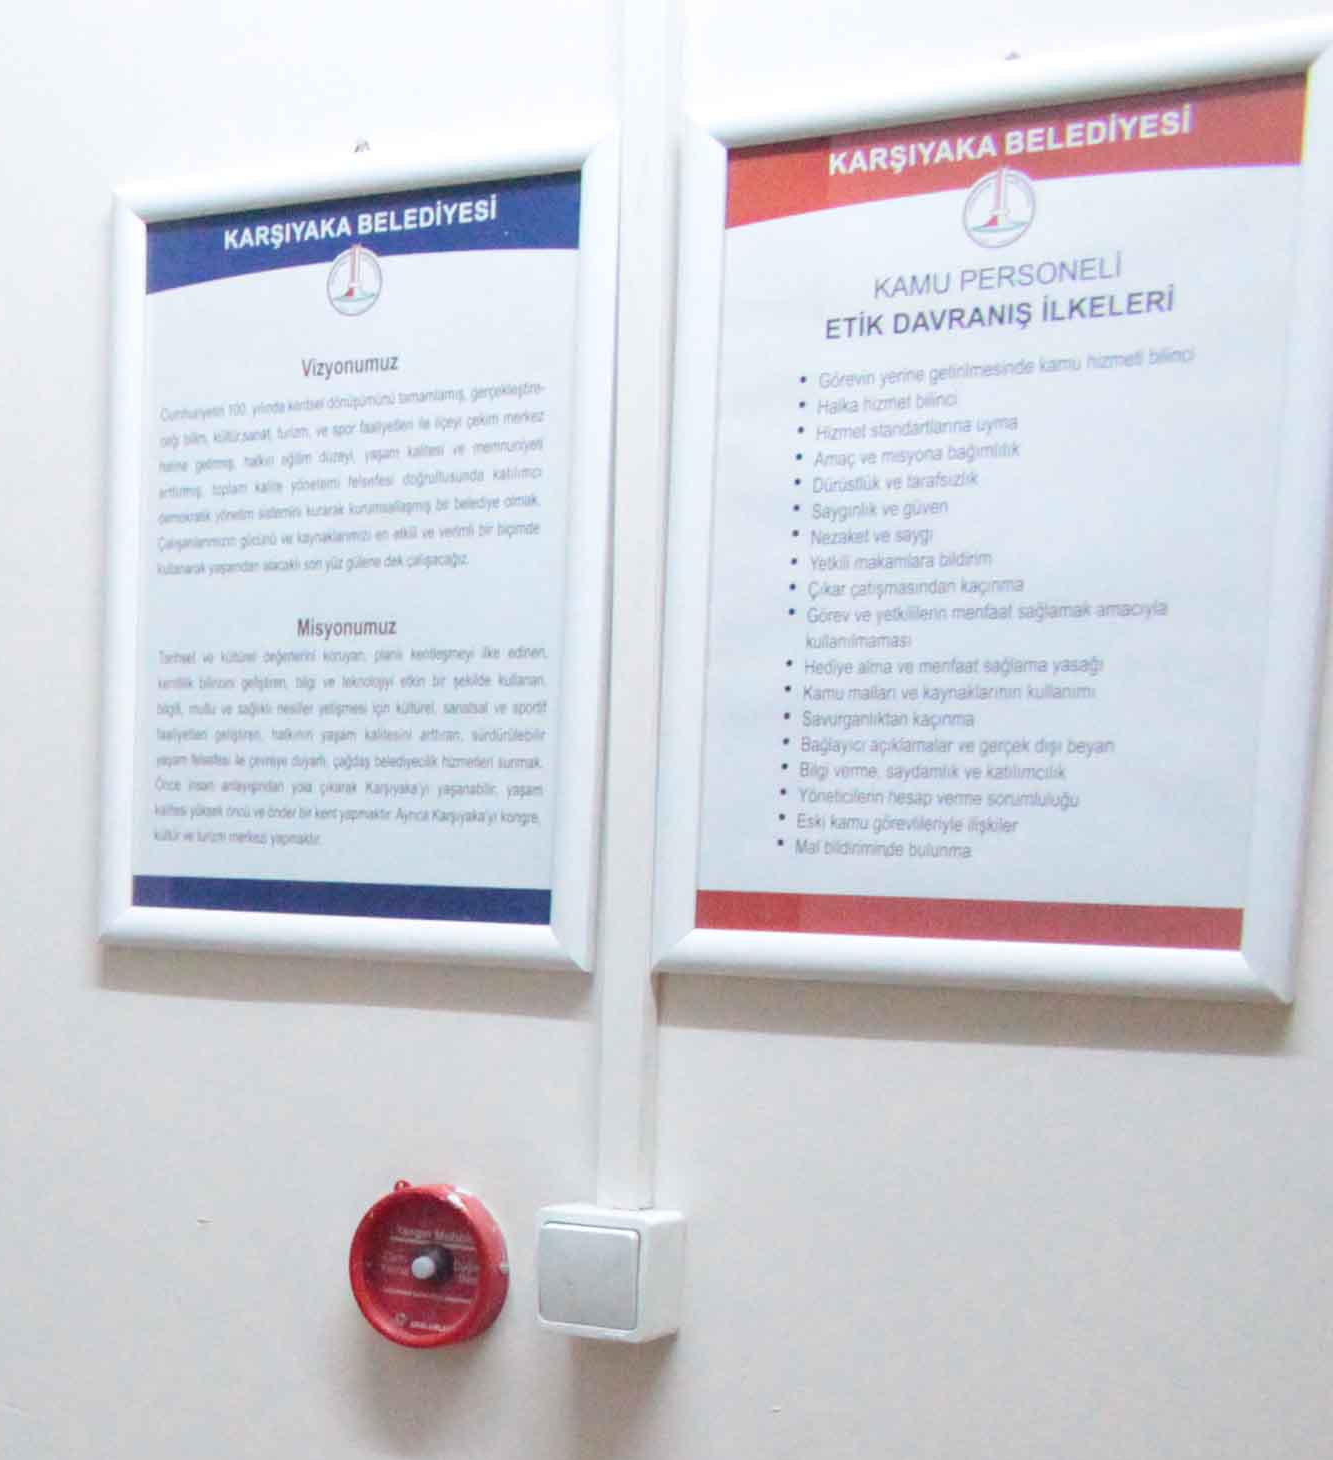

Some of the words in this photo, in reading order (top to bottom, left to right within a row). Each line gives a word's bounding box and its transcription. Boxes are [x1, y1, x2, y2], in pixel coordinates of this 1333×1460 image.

[829, 136, 997, 175] KARŞIYAKA
[1005, 104, 1192, 155] BELEDİYESİ
[224, 215, 352, 250] KARŞIYAKA
[358, 194, 497, 234] BELEDİYESİ
[873, 271, 952, 300] KAMU
[959, 250, 1122, 292] PERSONELİ
[825, 310, 884, 340] ETİK
[892, 301, 1033, 335] DAVRANIŞ
[1042, 283, 1174, 323] İLKELERİ
[301, 355, 399, 381] Vizyonumuz
[296, 617, 397, 641] Misyonumuz
